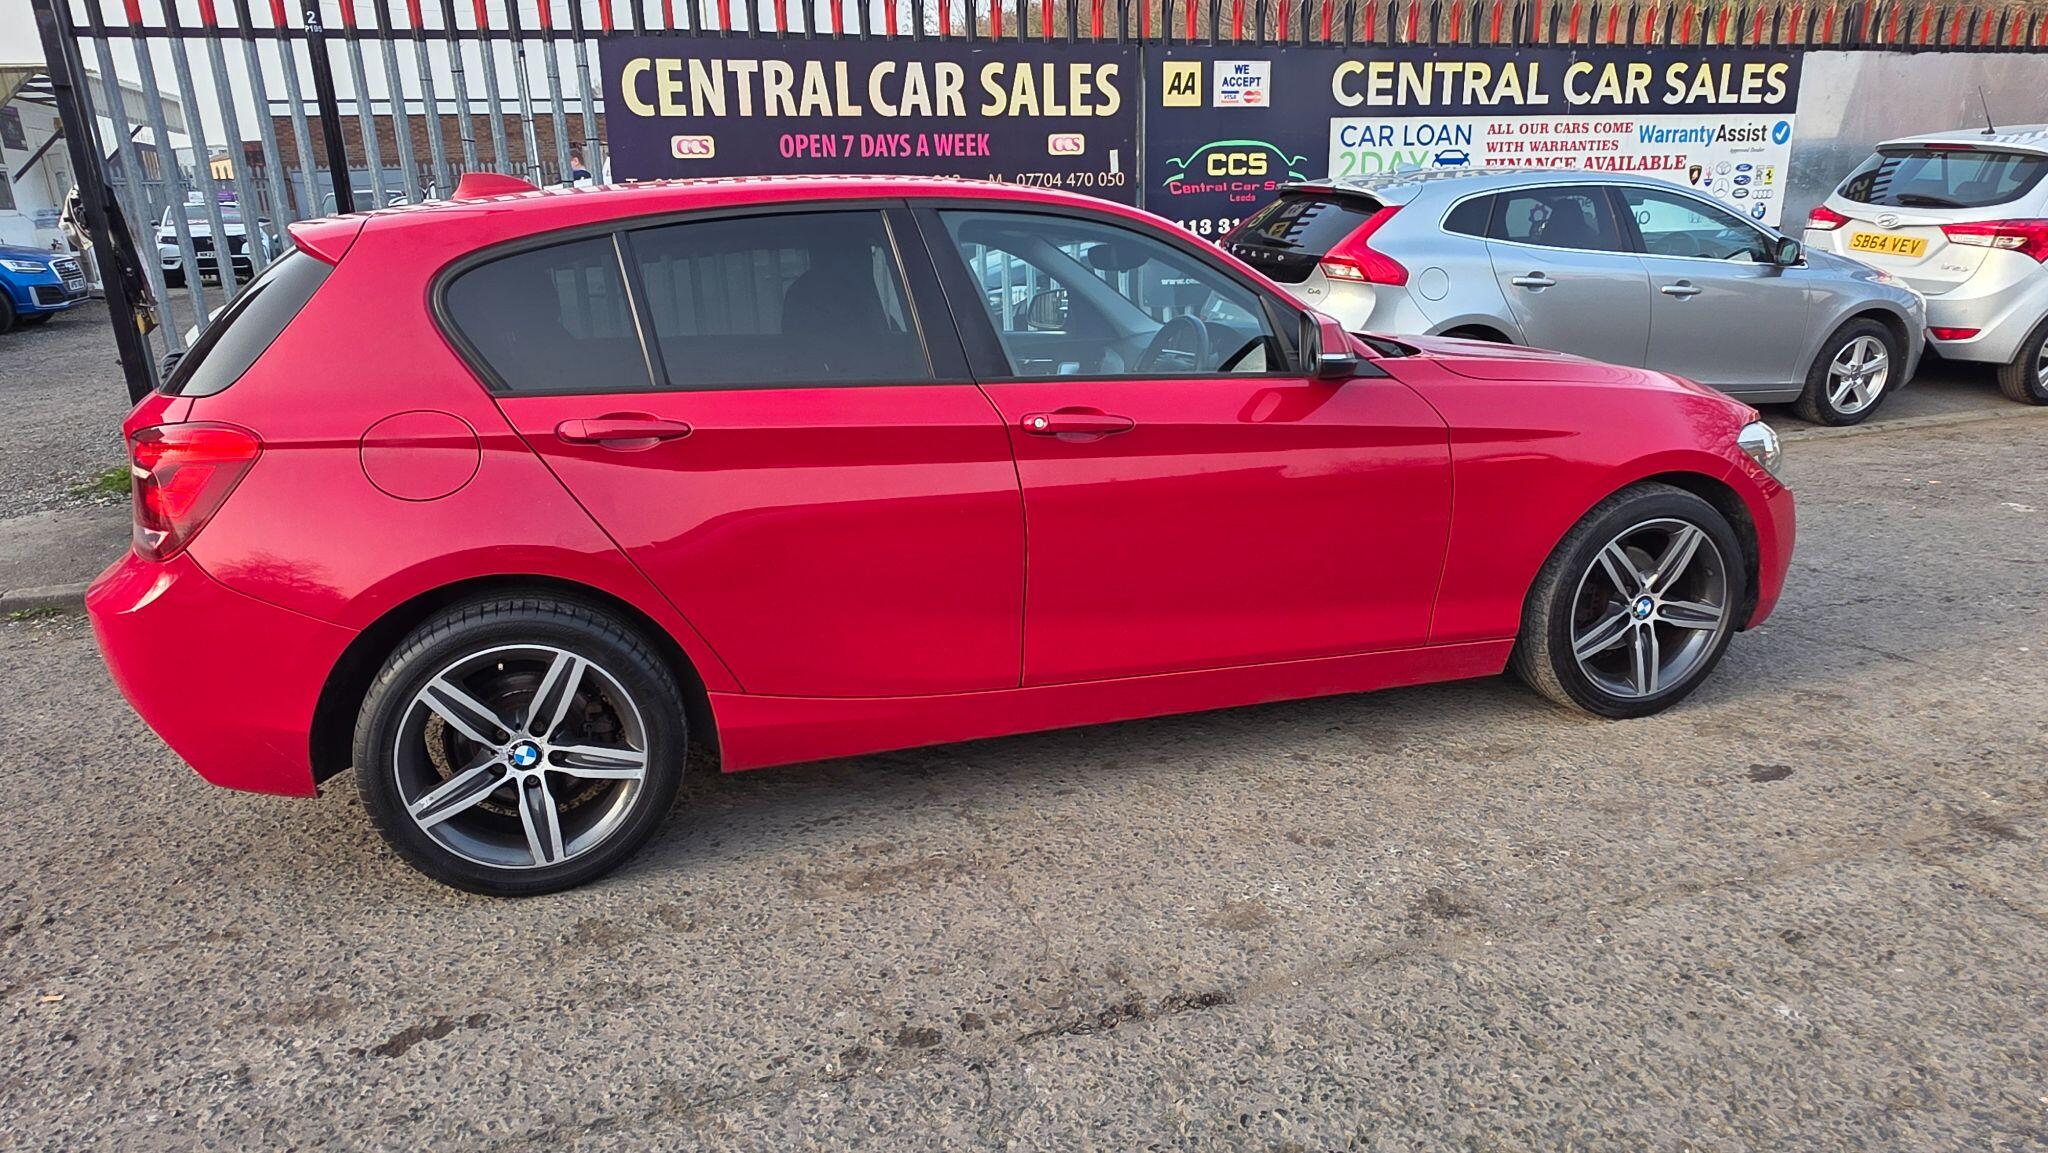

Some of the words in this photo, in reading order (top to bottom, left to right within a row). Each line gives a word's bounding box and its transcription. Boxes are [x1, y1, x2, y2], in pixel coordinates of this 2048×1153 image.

[306, 11, 316, 24] 2
[1234, 64, 1250, 75] WE
[621, 58, 862, 117] CENTRAL
[868, 61, 967, 117] CAR
[980, 62, 1121, 117] SALES
[1167, 72, 1196, 95] AA
[1222, 76, 1262, 88] ACCEPT
[1332, 60, 1549, 107] CENTRAL
[1563, 61, 1652, 105] CAR
[1662, 62, 1789, 105] SALES
[1340, 125, 1394, 147] CAR
[1403, 124, 1473, 146] LOAN
[1487, 123, 1514, 135] ALL
[1519, 122, 1549, 134] OUR
[1554, 122, 1589, 134] CARS
[1594, 122, 1634, 133] COME
[779, 134, 837, 159] OPEN
[842, 135, 855, 158] 7
[860, 134, 911, 158] DAYS
[916, 134, 930, 157] A
[934, 133, 991, 157] WEEK
[1486, 141, 1524, 153] WITH
[1530, 140, 1619, 152] WARRANTIES
[1207, 153, 1268, 176] CCS
[1584, 155, 1687, 171] AVAILABLE
[1016, 173, 1062, 187] 07704
[1066, 173, 1093, 187] 470
[1098, 172, 1125, 187] 050
[1169, 181, 1227, 195] Central
[1231, 182, 1260, 191] Car
[1229, 193, 1256, 202] Leeds
[1853, 234, 1888, 250] SB64
[1891, 237, 1921, 254] VEV
